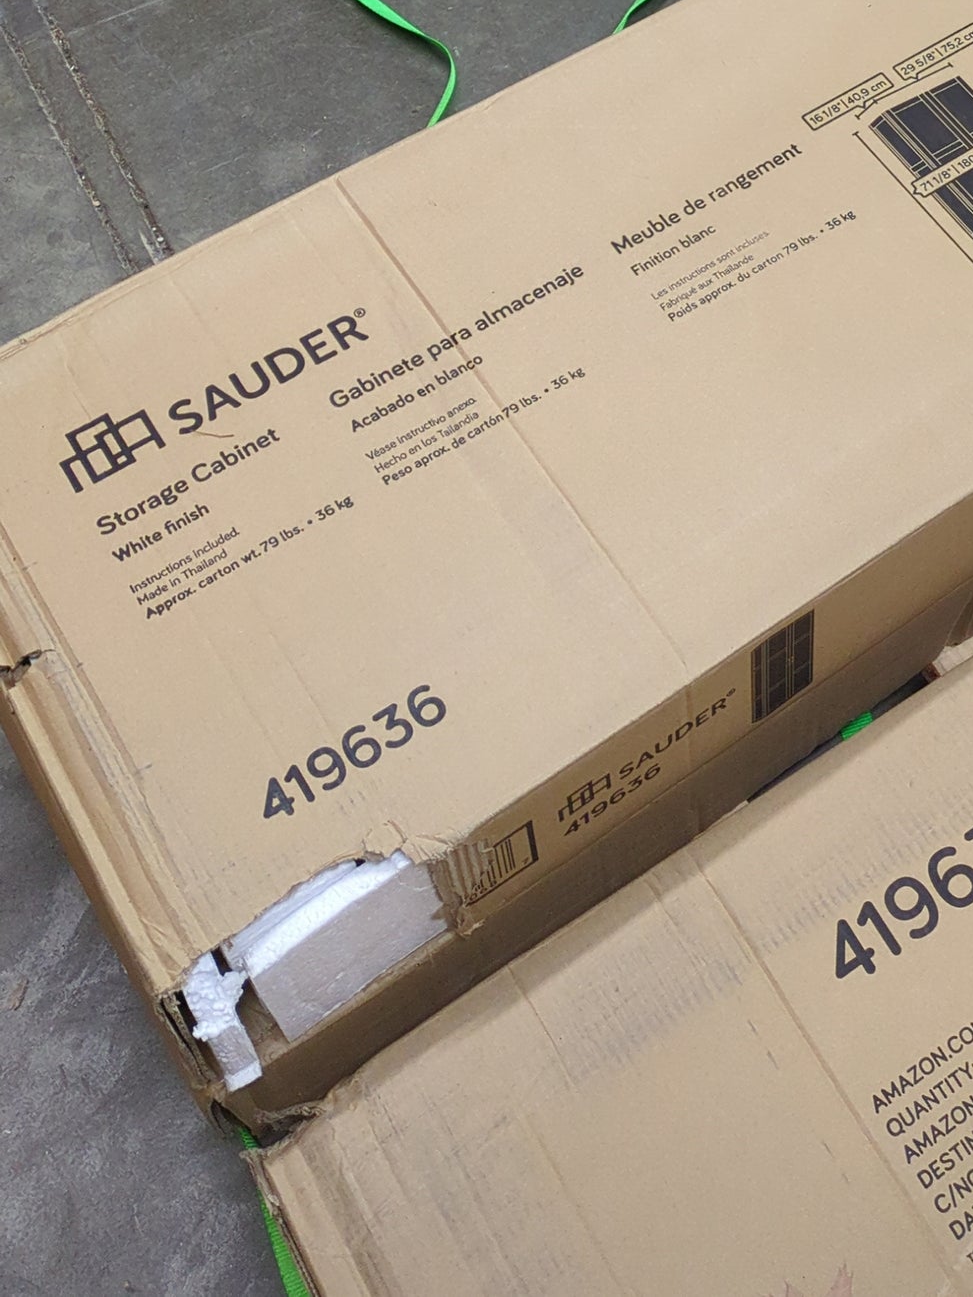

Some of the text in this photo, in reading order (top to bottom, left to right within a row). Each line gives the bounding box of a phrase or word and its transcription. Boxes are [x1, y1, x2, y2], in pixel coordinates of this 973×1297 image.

[901, 62, 915, 76] 29
[809, 112, 824, 125] 16
[870, 79, 888, 93] cm
[611, 143, 802, 254] Meuble de rangement
[920, 180, 932, 192] 71
[630, 224, 716, 276] Finition blanc
[651, 287, 669, 301] Les
[667, 260, 716, 292] instructions
[716, 247, 735, 264] sont
[667, 209, 856, 322] Poids approx. du carton 79 lbs. 36 kg
[659, 285, 697, 312] Fabriqué
[697, 277, 714, 291] aux
[329, 265, 584, 408] Gabinete para almacenaje
[351, 354, 483, 433] Acabado en blanco
[364, 440, 397, 461] Véase
[396, 413, 446, 444] instructivo
[373, 410, 480, 474] Hecho en los Tailandia
[381, 366, 585, 486] Peso aprox. de cartón 79 lbs. 36 kg
[96, 427, 280, 535] Storage Cabinet
[112, 503, 210, 562] White finish
[146, 494, 354, 619] Approx. carton wt. 79 lbs. 36 kg
[129, 555, 192, 594] Instructions
[136, 548, 228, 605] Made in Thailand
[262, 684, 447, 819] 419636
[563, 763, 662, 836] 419636
